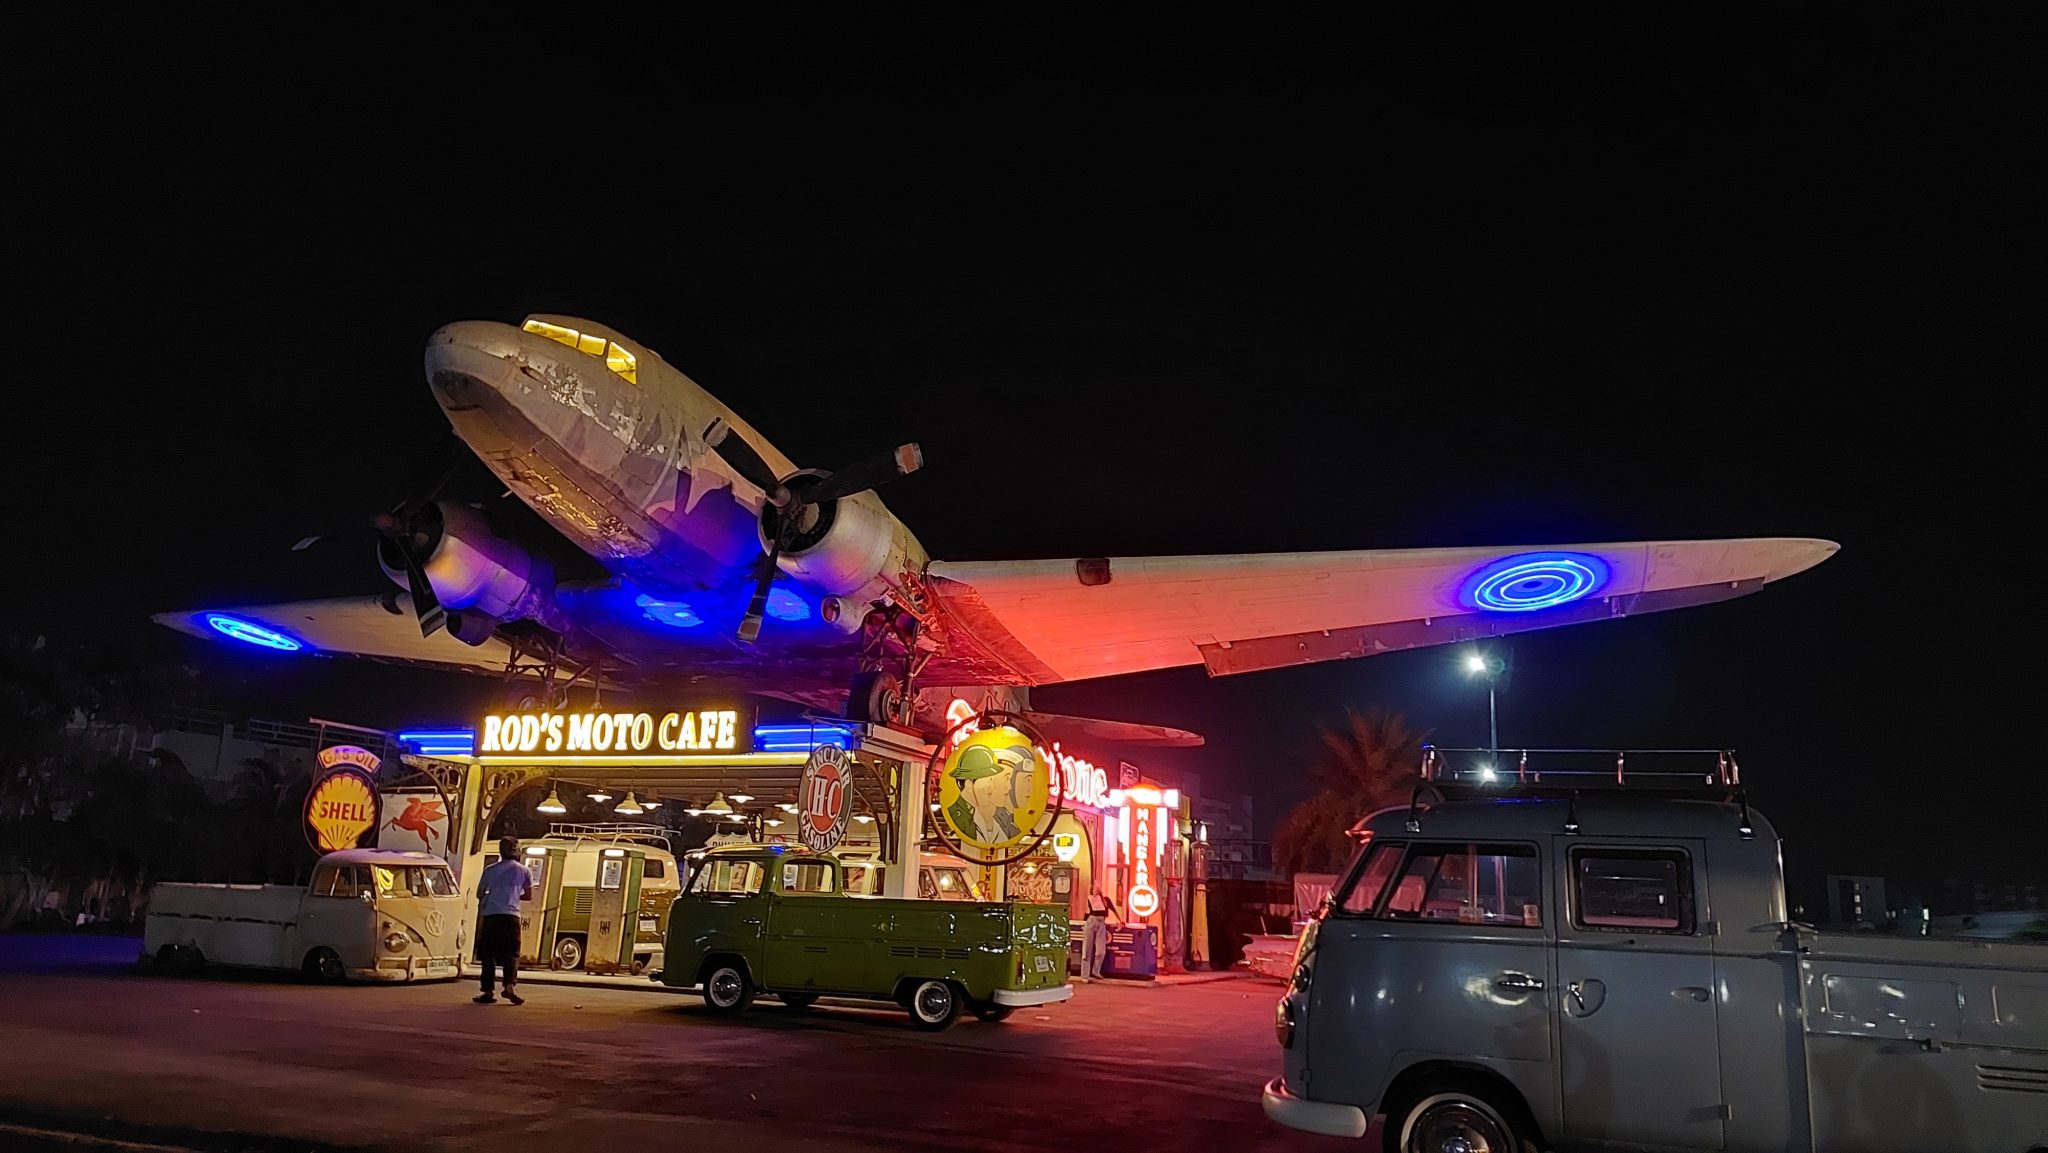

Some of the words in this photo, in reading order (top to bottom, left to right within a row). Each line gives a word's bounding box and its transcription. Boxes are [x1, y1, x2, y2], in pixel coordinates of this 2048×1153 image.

[481, 713, 564, 751] ROD'S
[566, 713, 653, 751] MOTO
[658, 710, 738, 750] CAFE
[322, 749, 350, 765] GAS
[355, 751, 380, 770] OIL
[806, 747, 850, 789] SINCLAIR
[319, 801, 367, 822] SHELL
[801, 810, 845, 850] GASOLINE
[1059, 837, 1071, 846] BP
[1136, 808, 1149, 885] HANGAR
